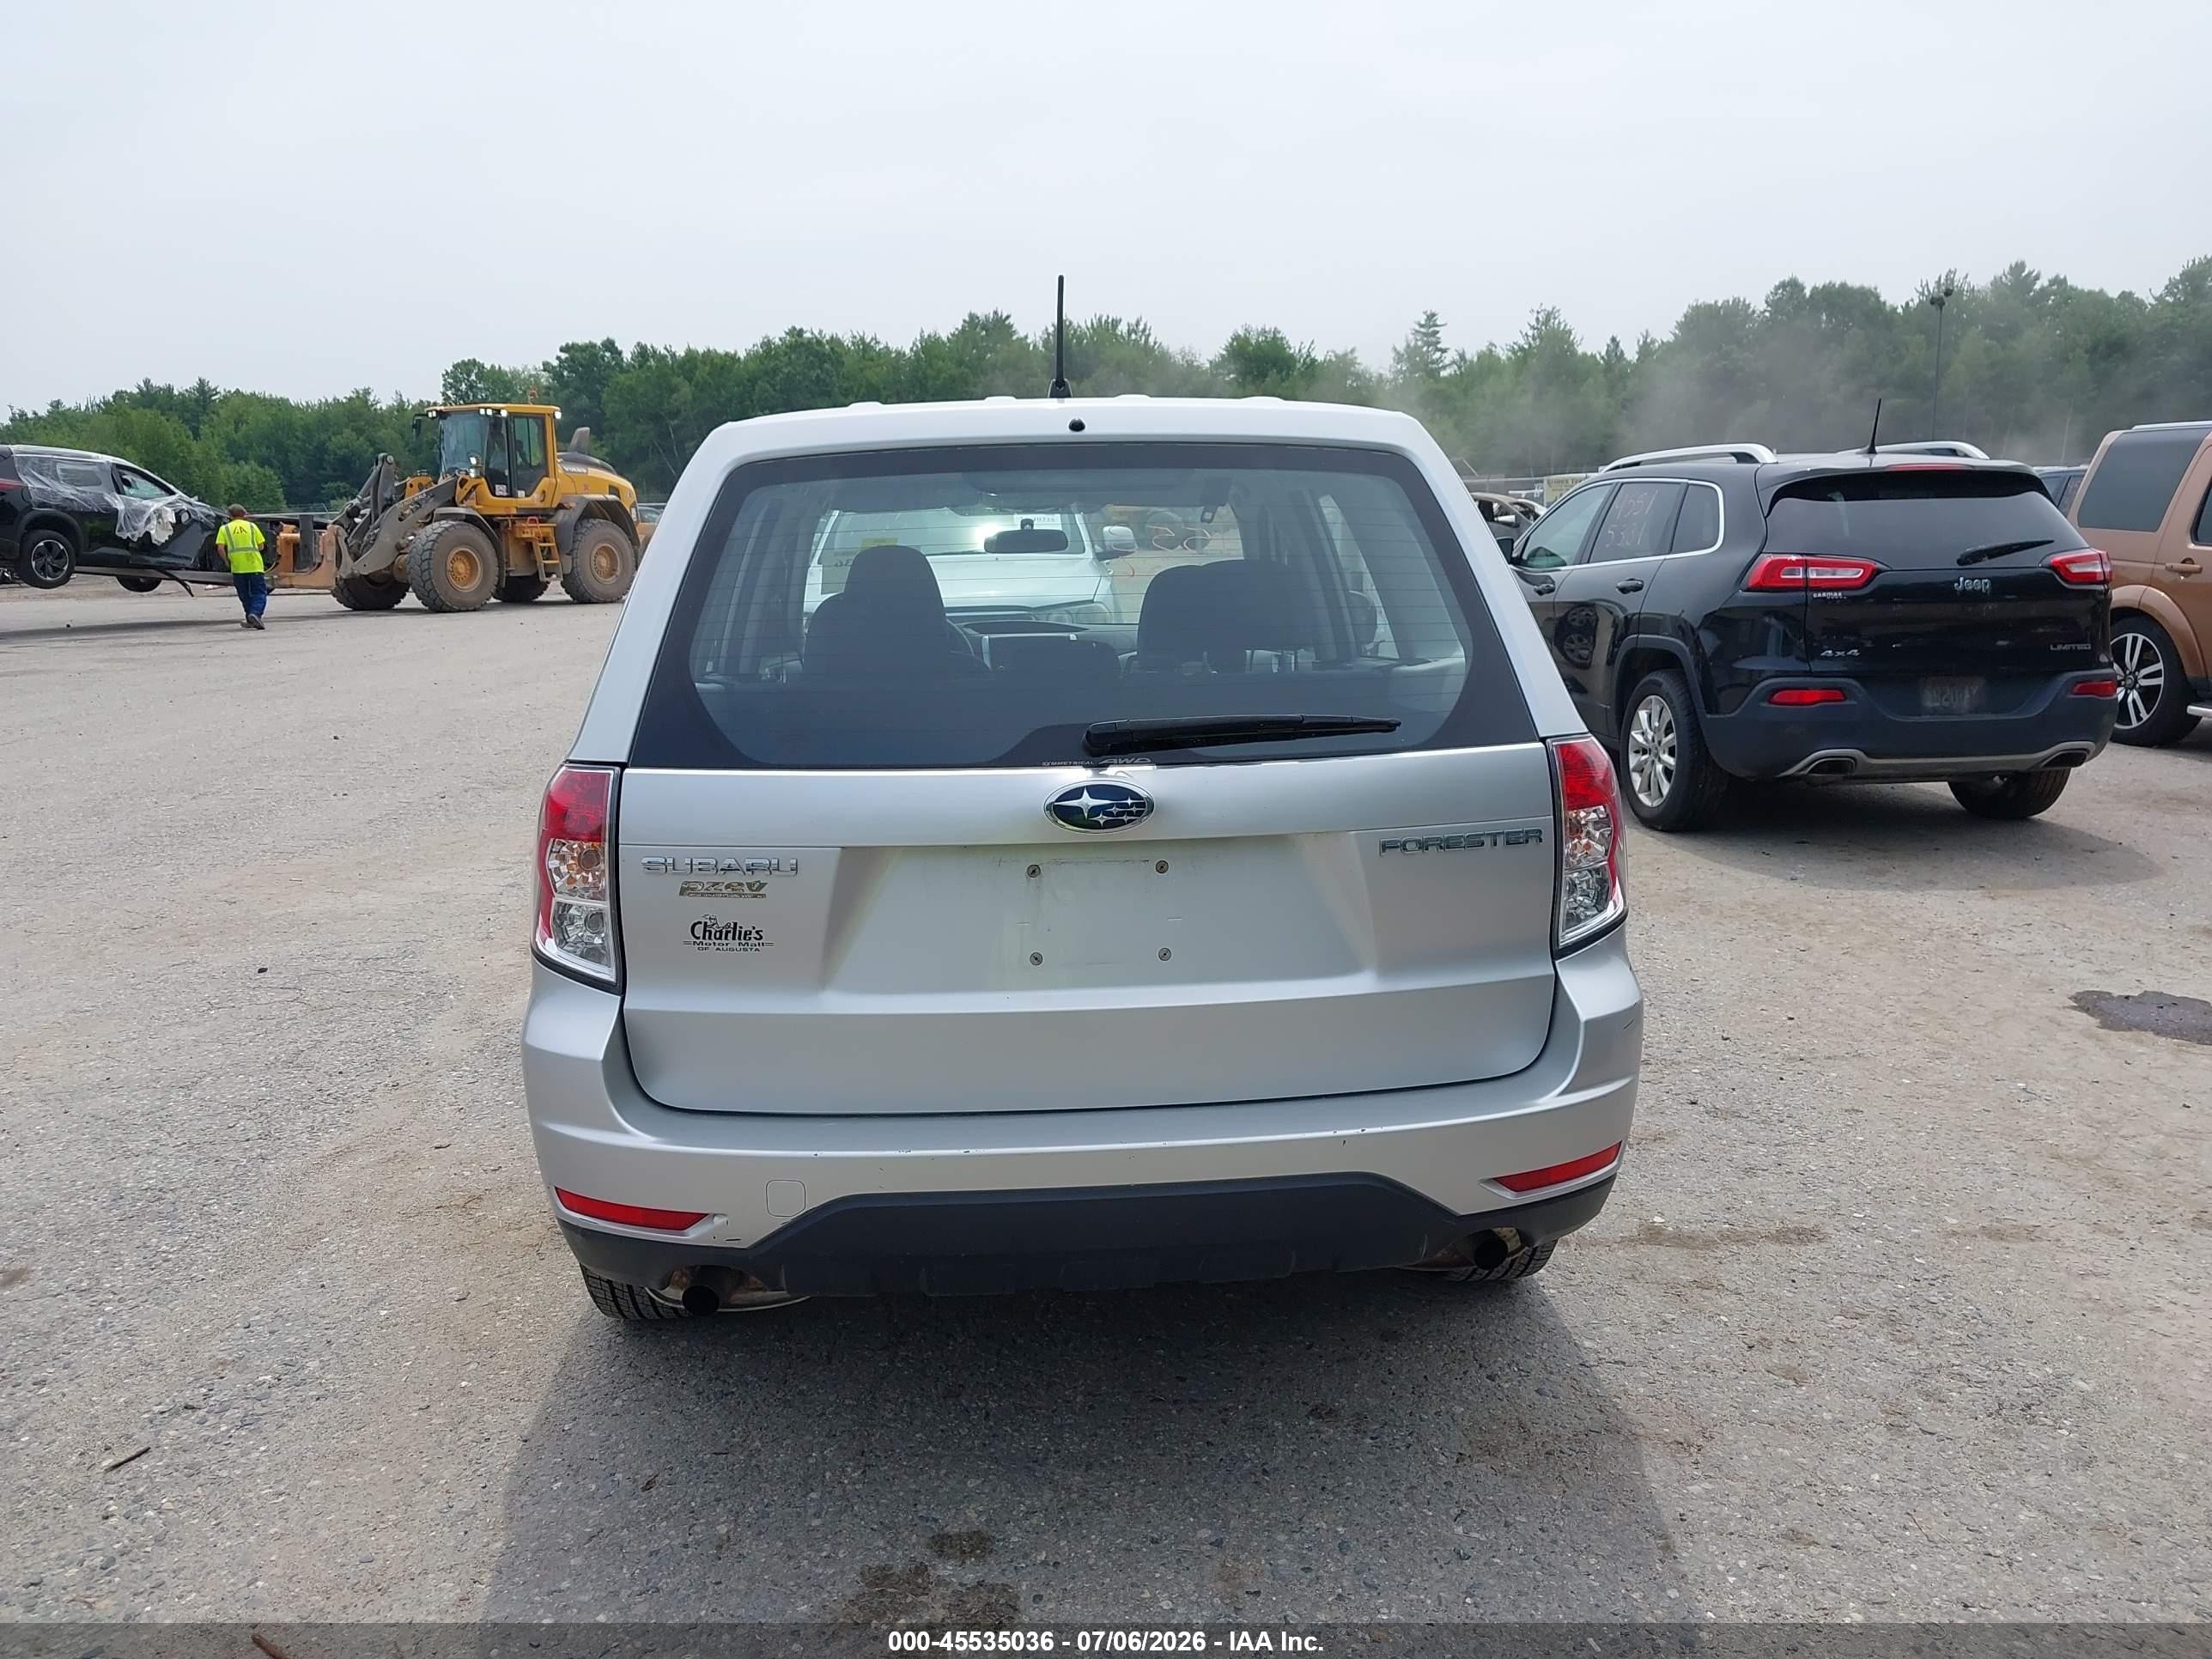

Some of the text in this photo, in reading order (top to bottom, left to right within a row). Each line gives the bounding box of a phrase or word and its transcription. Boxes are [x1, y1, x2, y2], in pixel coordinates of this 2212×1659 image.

[1954, 576, 1992, 593] Jeep
[1820, 649, 1861, 658] 4x4
[1379, 827, 1544, 856] FORESTER
[641, 856, 798, 876] SUBARU
[690, 920, 763, 941] Charlie's
